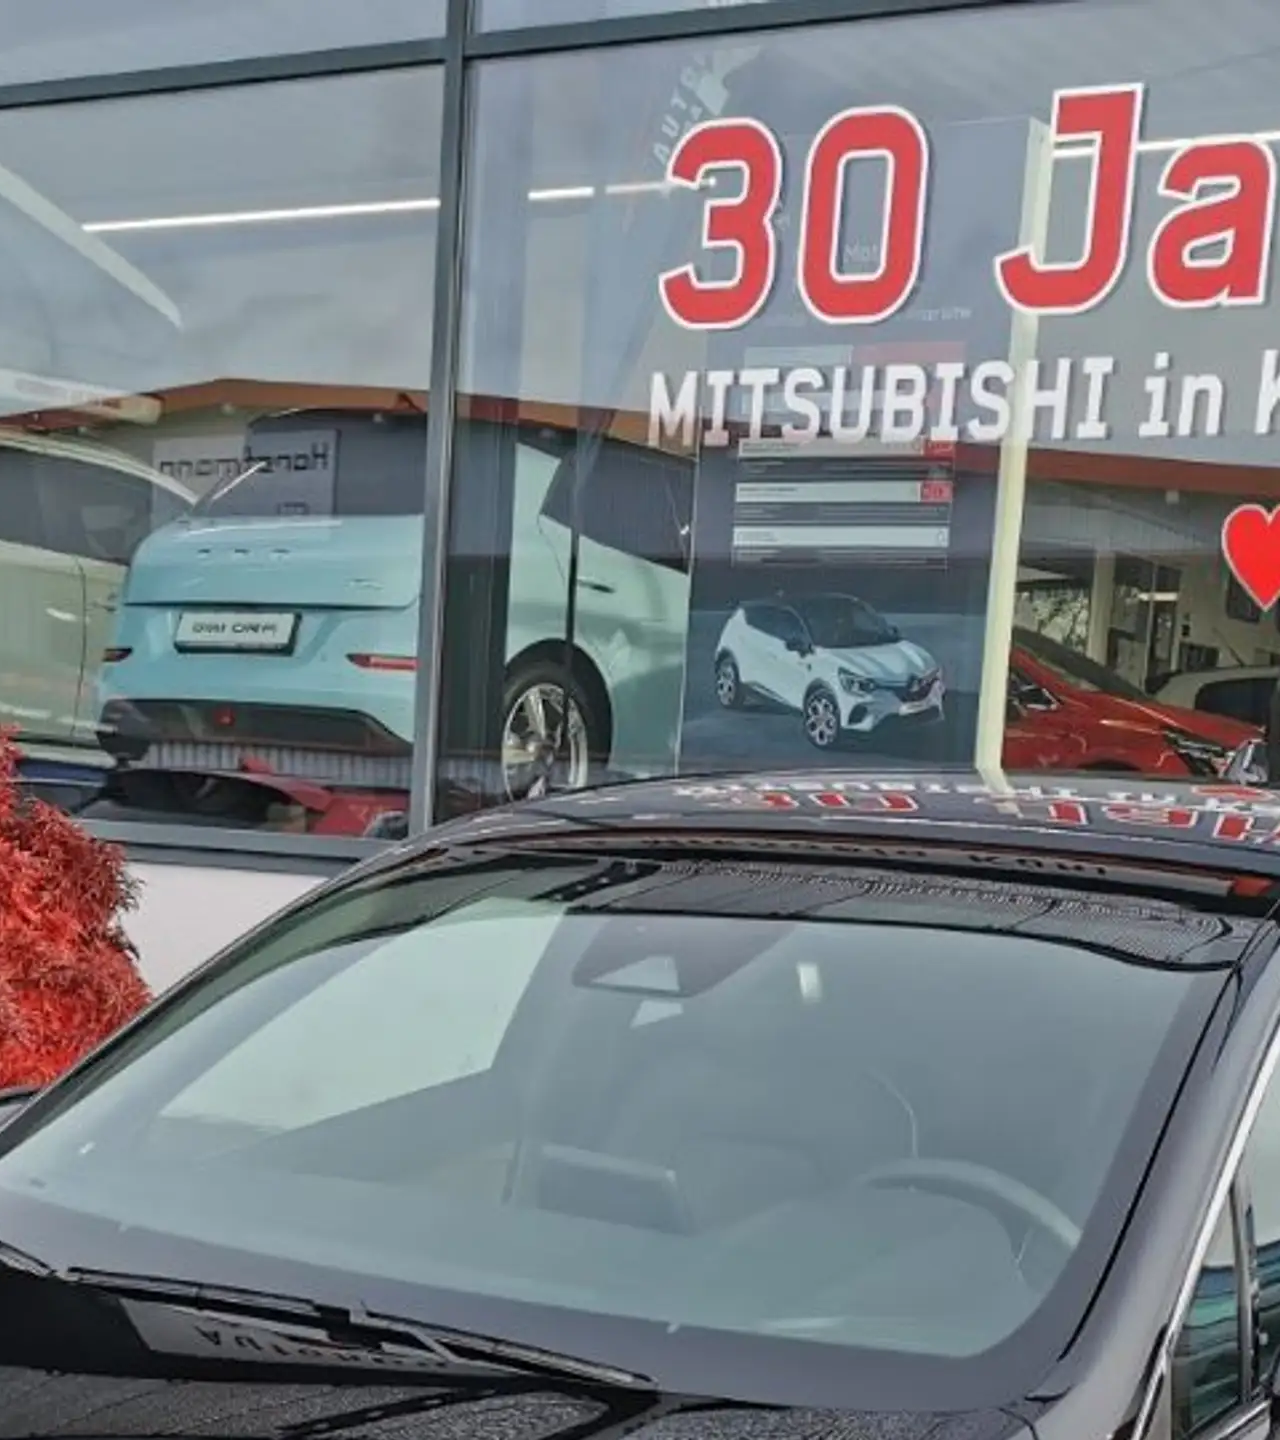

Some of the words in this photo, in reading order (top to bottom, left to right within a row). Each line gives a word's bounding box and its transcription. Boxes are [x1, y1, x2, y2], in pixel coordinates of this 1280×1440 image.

[659, 105, 930, 329] 30
[647, 356, 1114, 447] MITSUBISHI
[1137, 351, 1222, 438] in
